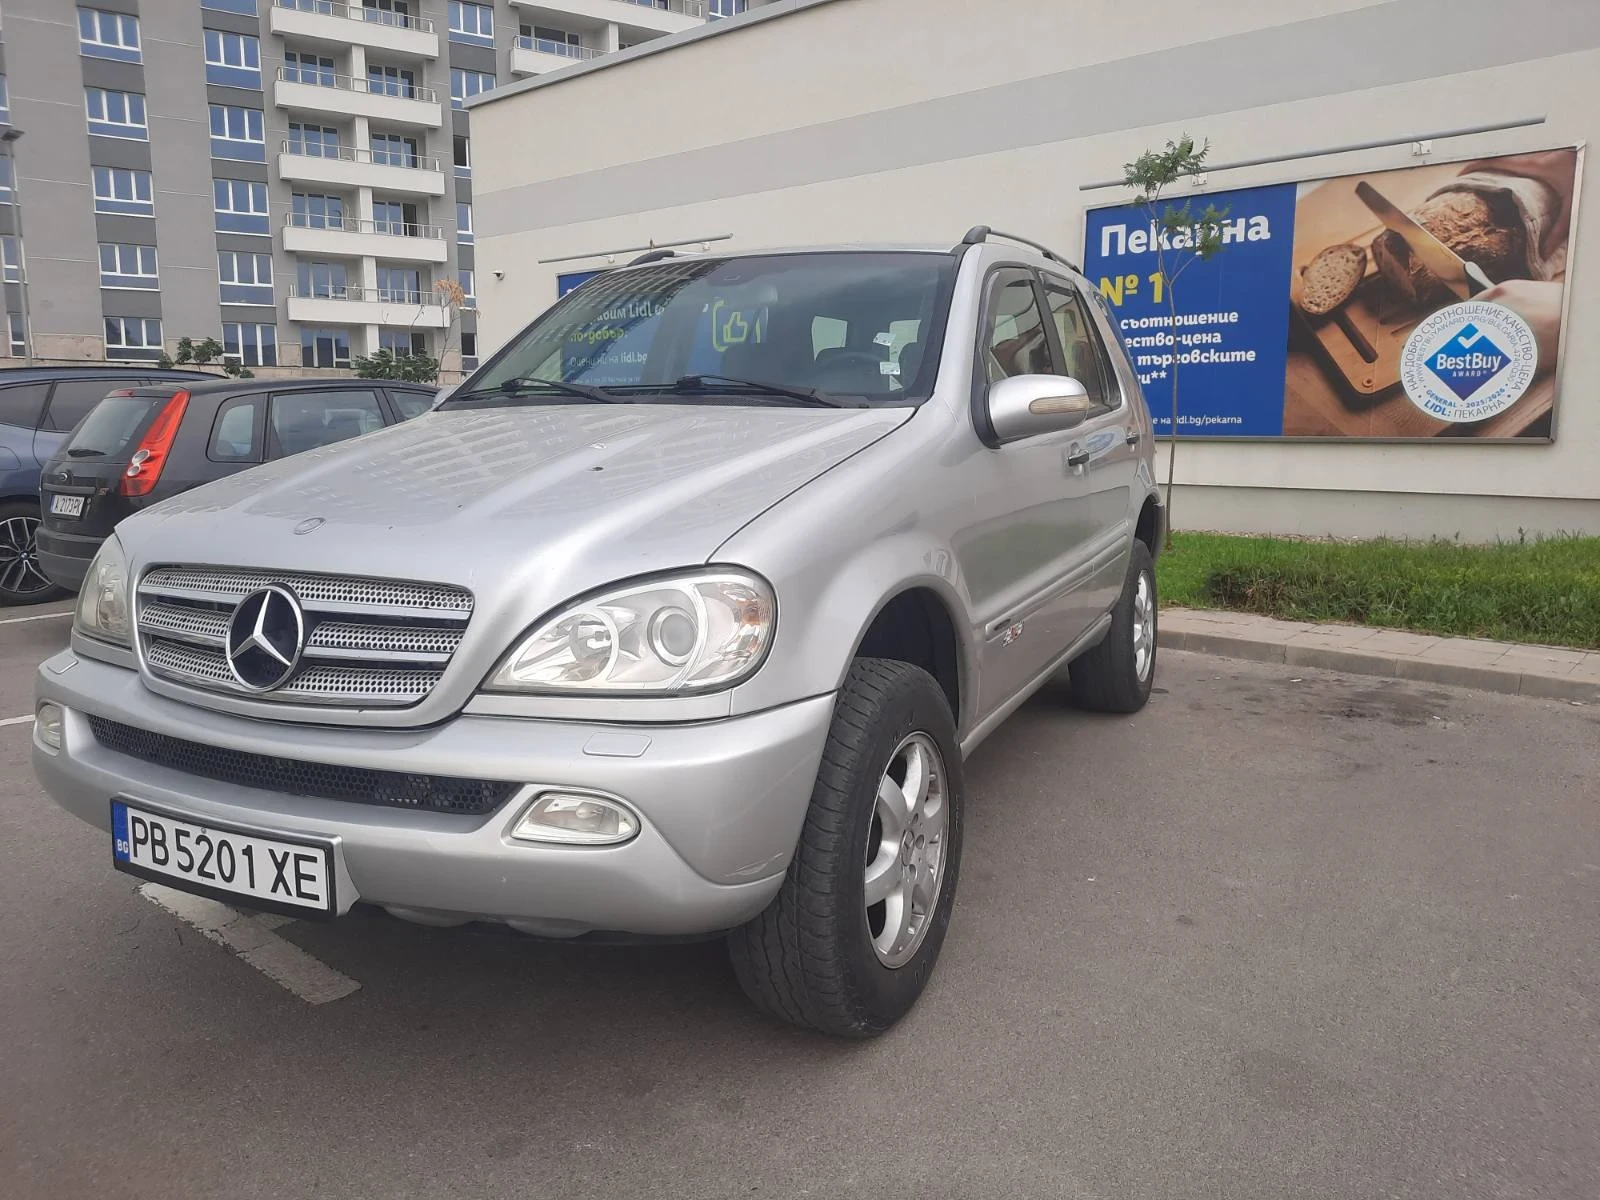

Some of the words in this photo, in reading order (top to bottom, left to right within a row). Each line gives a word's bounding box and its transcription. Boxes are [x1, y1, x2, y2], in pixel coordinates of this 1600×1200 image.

[629, 301, 652, 318] Lidl
[1120, 311, 1239, 330] съотношение
[1125, 331, 1222, 348] ество-цена
[1175, 414, 1242, 426] idl.bg/pekarna
[116, 838, 129, 854] BG
